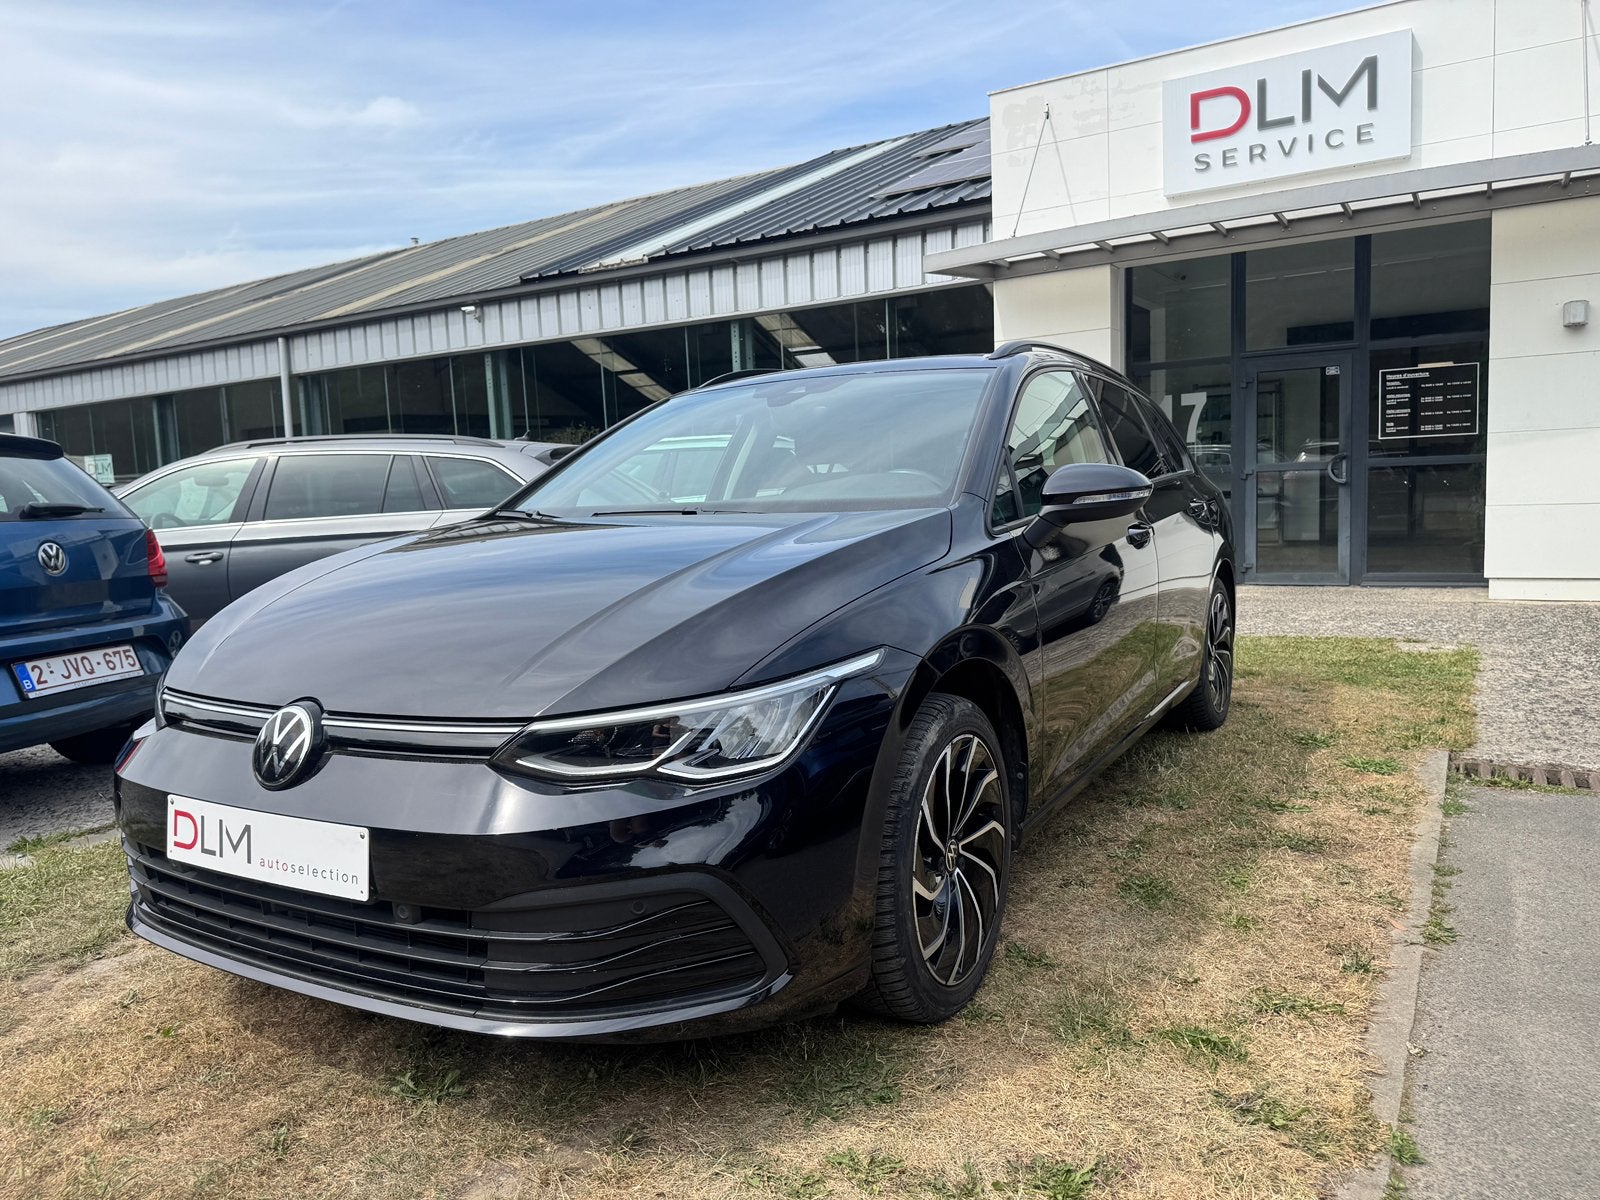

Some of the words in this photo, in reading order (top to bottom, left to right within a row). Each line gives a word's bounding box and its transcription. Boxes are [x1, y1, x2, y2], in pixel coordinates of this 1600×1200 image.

[1190, 55, 1378, 144] DLM
[1194, 122, 1374, 172] SERVICE
[23, 680, 33, 690] B
[173, 809, 252, 864] DLM
[259, 857, 358, 885] autoselection
